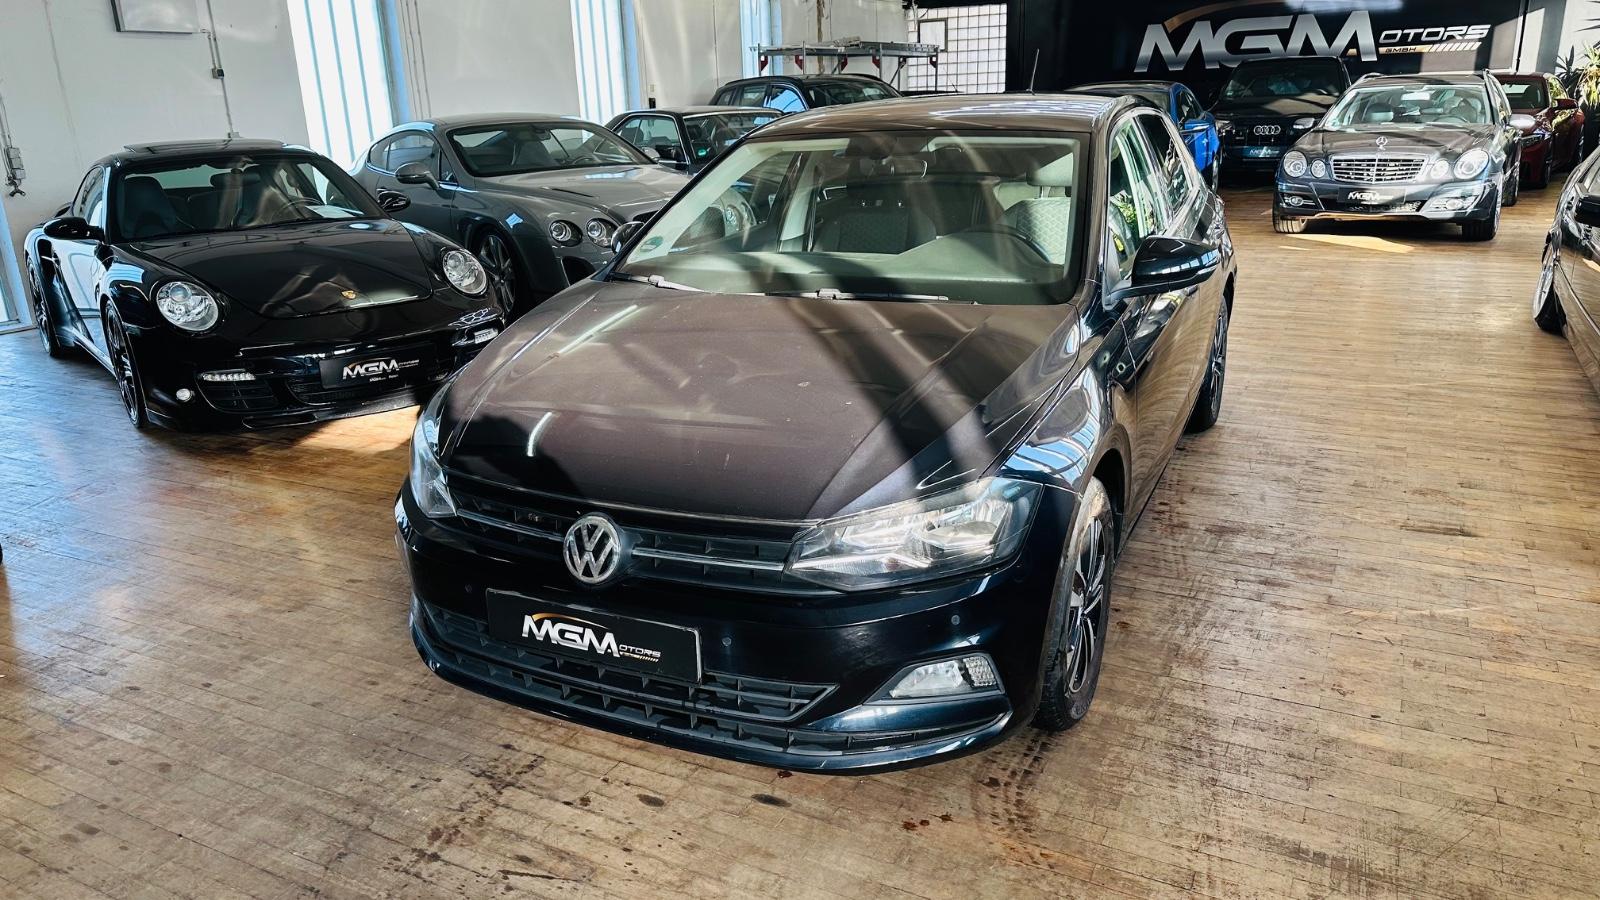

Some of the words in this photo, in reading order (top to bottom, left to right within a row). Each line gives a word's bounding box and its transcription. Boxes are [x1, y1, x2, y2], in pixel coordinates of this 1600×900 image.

[1133, 11, 1378, 72] MGM
[1347, 191, 1381, 201] MGM
[342, 359, 400, 380] MGM
[564, 515, 620, 583] VW
[522, 614, 621, 658] MGM
